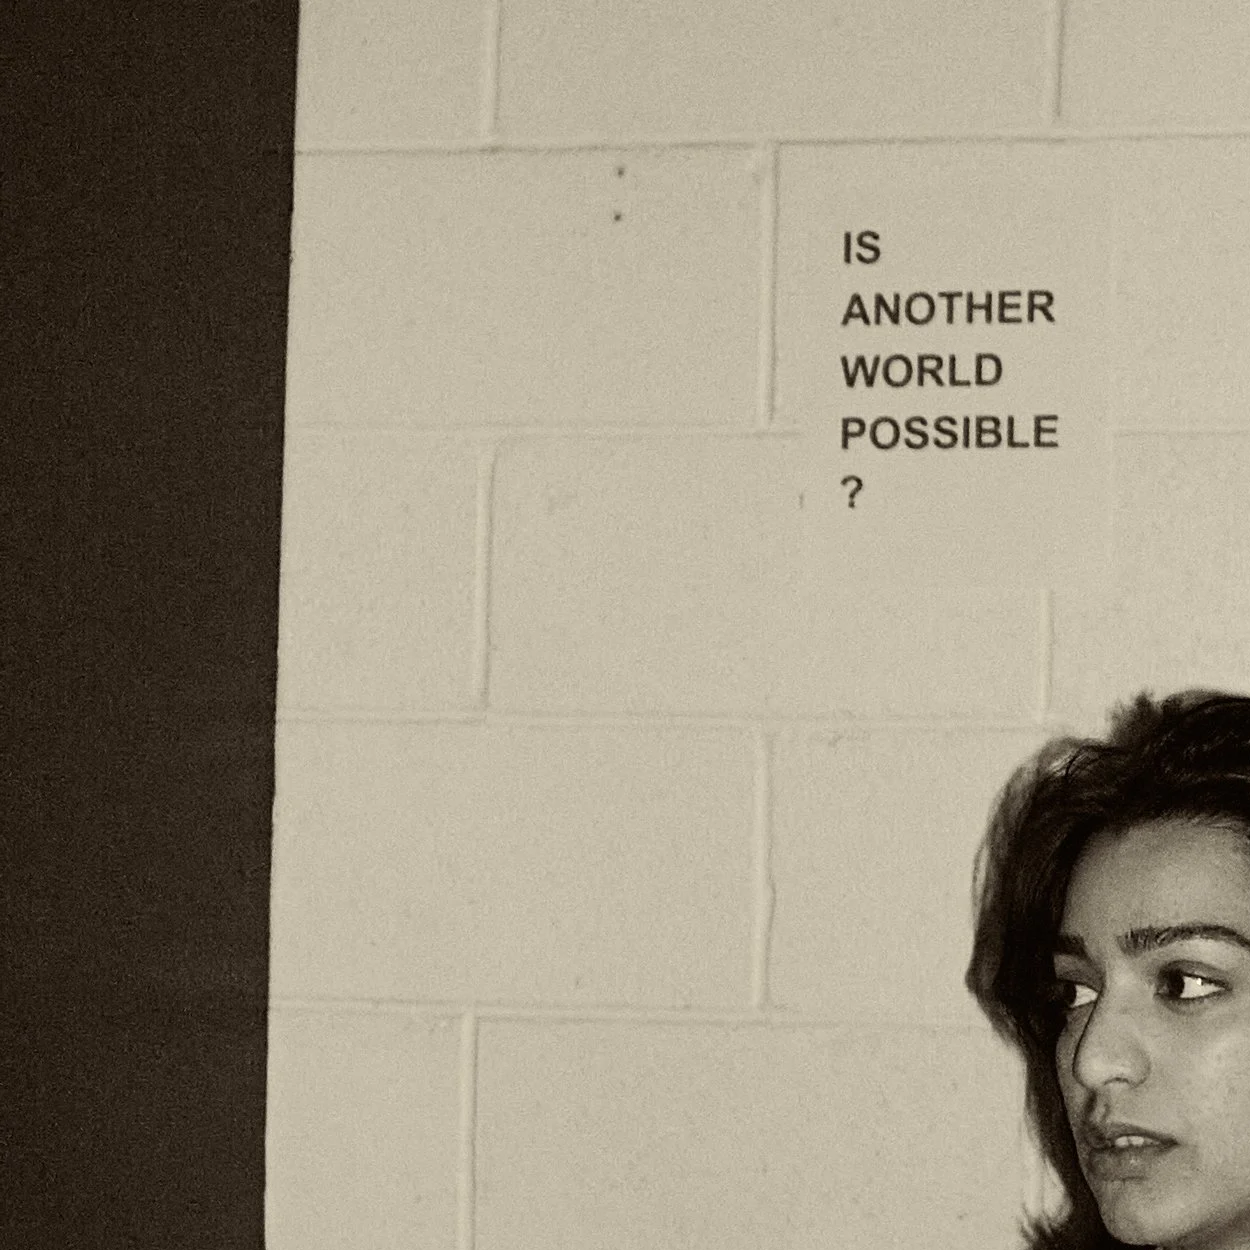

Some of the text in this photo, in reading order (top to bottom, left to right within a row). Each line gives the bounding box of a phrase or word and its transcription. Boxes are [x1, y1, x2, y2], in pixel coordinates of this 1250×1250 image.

[844, 230, 881, 264] IS
[841, 289, 1055, 326] ANOTHER
[840, 353, 1003, 388] WORLD
[841, 414, 1059, 450] POSSIBLE
[840, 475, 864, 508] ?
